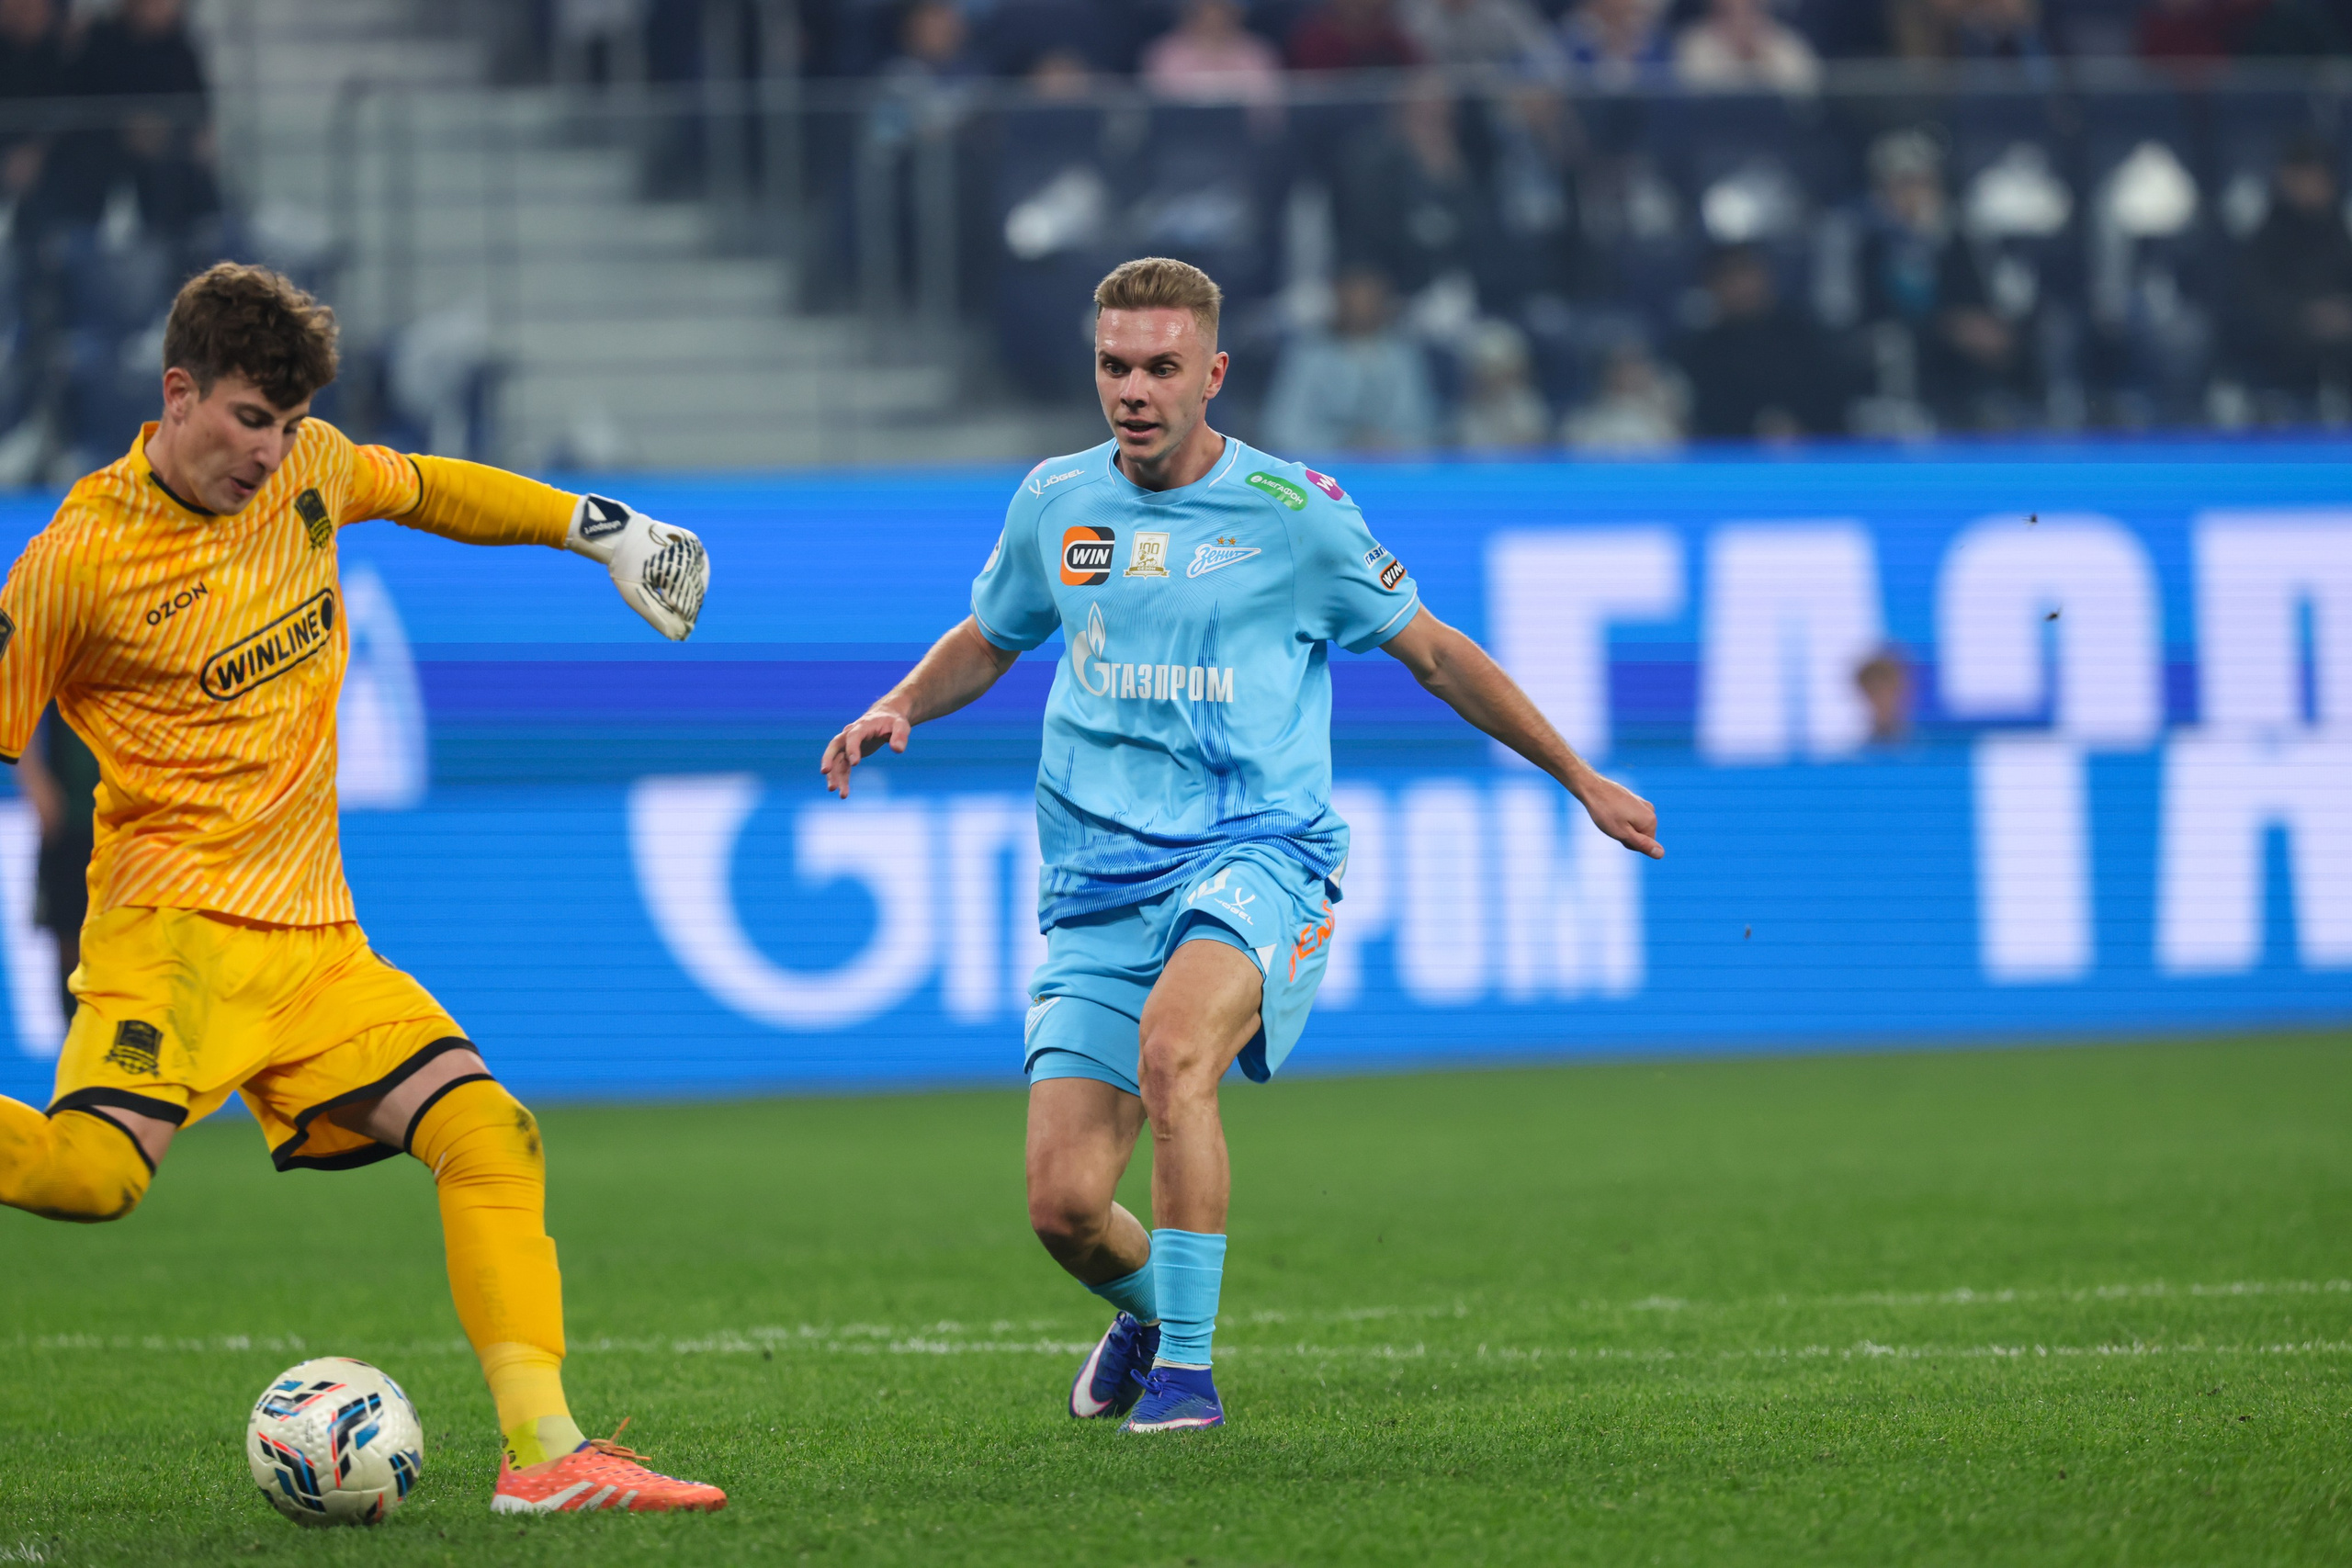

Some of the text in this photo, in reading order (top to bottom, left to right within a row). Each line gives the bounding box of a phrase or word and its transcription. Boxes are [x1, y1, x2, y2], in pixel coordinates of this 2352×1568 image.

[1261, 479, 1304, 504] МЕГАФОН
[1072, 548, 1110, 565] WIN
[1382, 561, 1404, 587] WIN
[146, 581, 209, 626] OZON
[217, 610, 320, 691] WINLINE
[1111, 662, 1234, 704] ГАЗПРОМ
